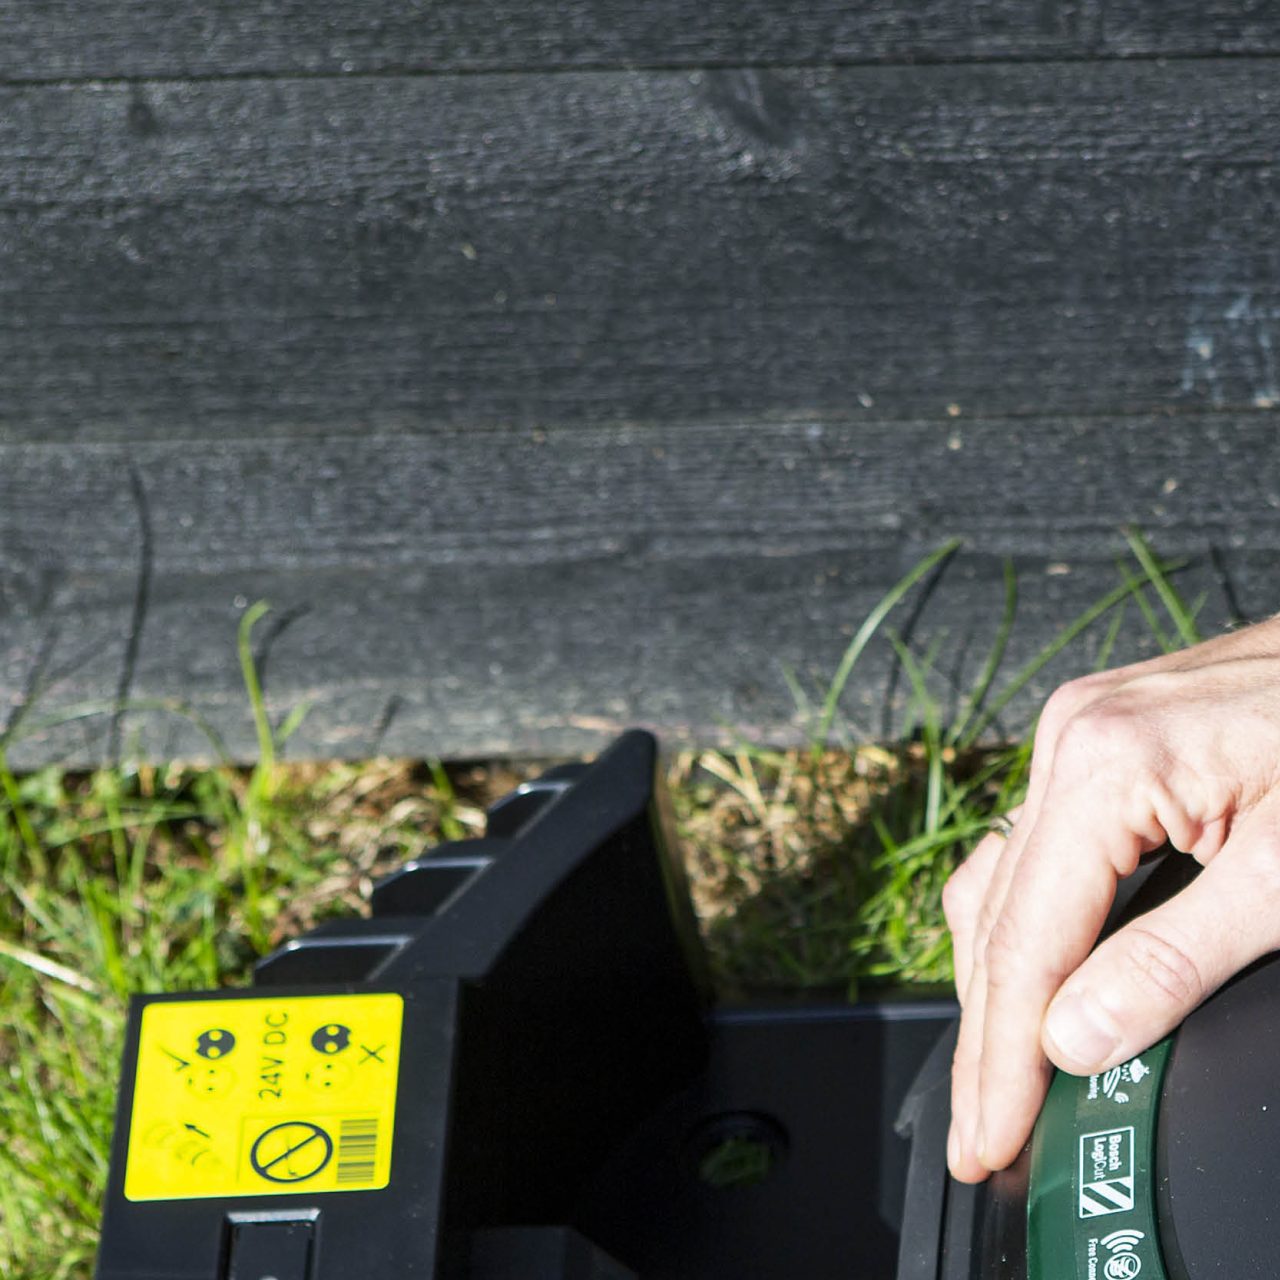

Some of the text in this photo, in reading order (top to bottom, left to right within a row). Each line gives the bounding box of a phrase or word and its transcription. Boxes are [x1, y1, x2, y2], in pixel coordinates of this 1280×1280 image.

[258, 1012, 289, 1100] 24V DC
[1091, 1136, 1107, 1181] LogiCut
[1108, 1134, 1122, 1171] Bosch
[1088, 1237, 1099, 1257] Free
